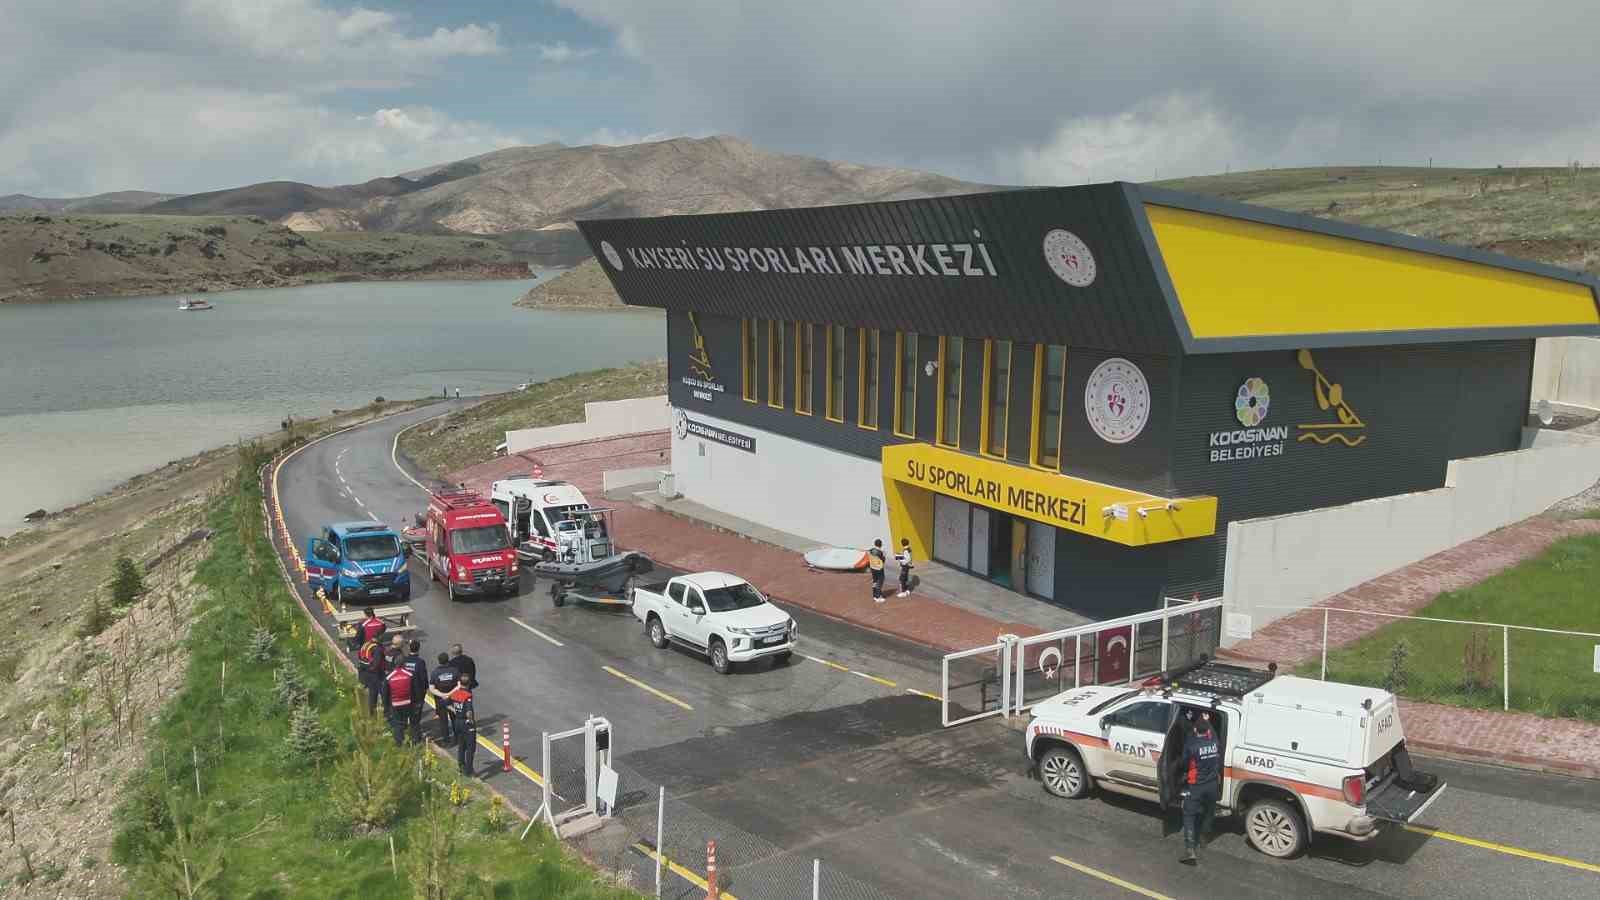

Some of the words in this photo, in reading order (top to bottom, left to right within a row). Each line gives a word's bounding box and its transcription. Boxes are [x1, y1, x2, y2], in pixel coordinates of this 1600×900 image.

[627, 239, 699, 271] KAYSERİ
[697, 247, 726, 272] SU
[724, 246, 843, 274] SPORLARI
[841, 229, 998, 277] MERKEZİ
[1210, 441, 1285, 462] BELEDİYESİ
[907, 459, 926, 482] SU
[928, 465, 1001, 504] SPORLARI
[1007, 485, 1087, 527] MERKEZİ
[1376, 714, 1393, 737] AFAD
[1114, 740, 1146, 759] AFAD
[1245, 754, 1275, 770] AFAD
